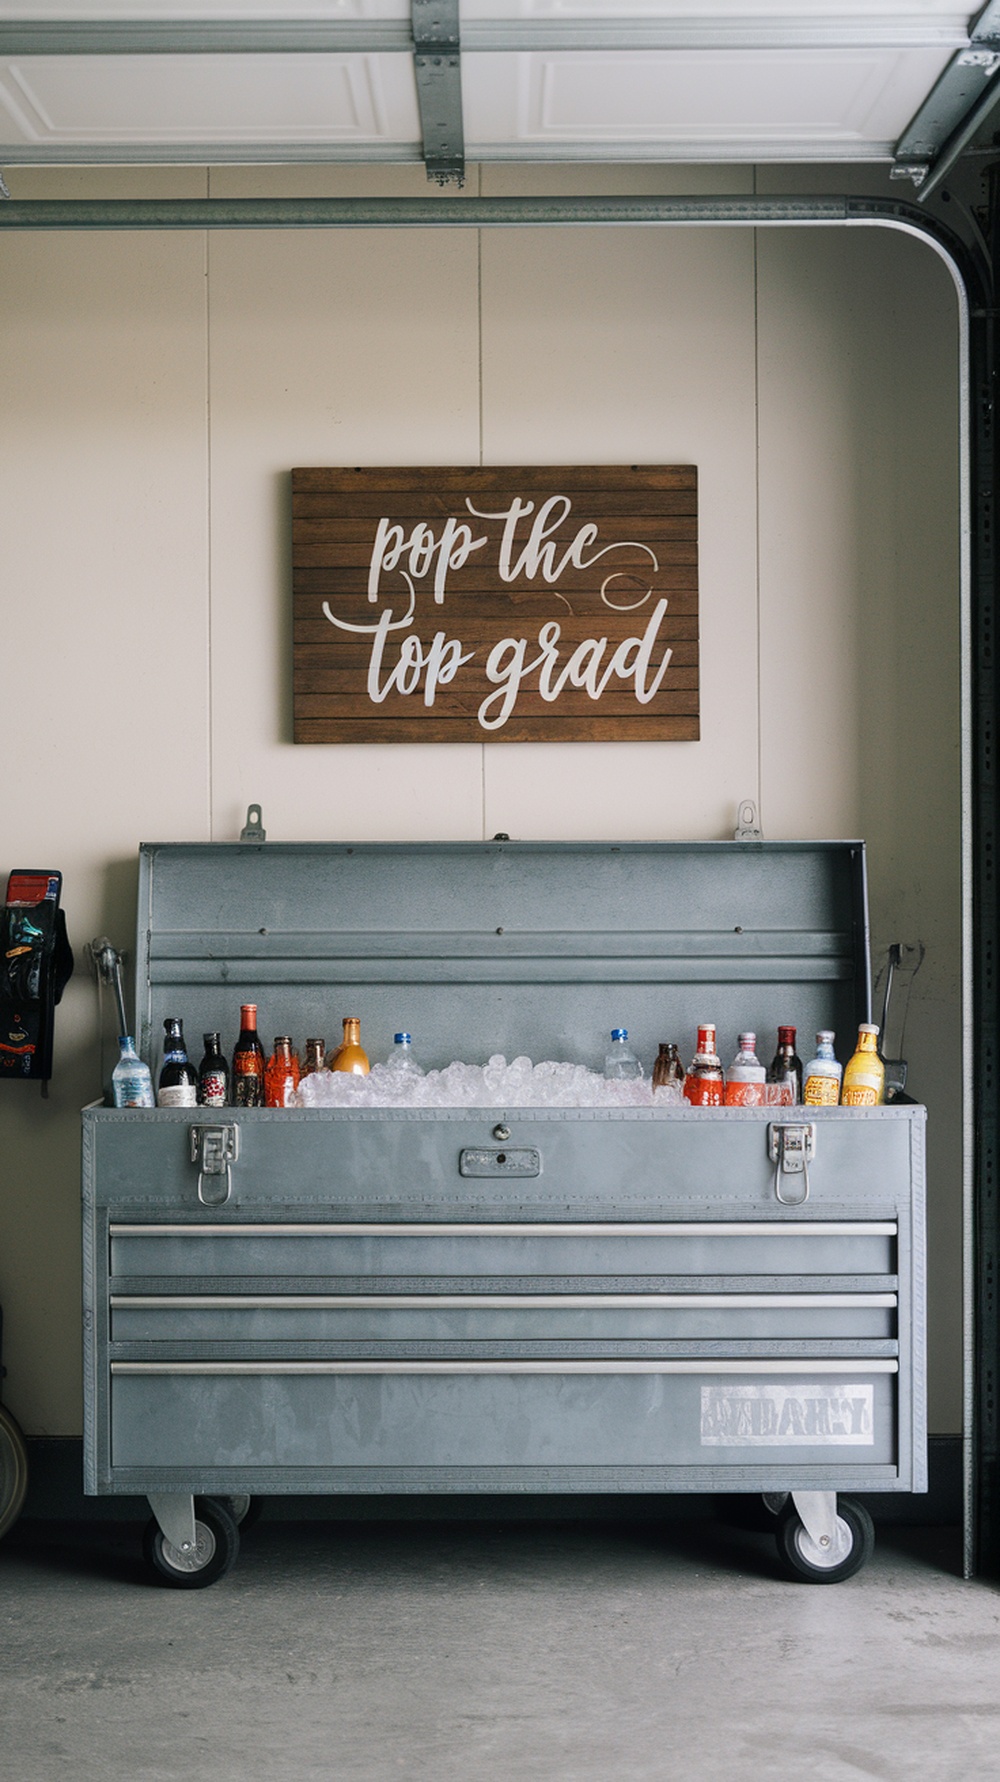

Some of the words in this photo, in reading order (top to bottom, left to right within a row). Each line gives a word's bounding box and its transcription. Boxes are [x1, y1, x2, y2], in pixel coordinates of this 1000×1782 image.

[368, 517, 488, 604] pop
[465, 495, 660, 583] the
[321, 600, 476, 707] top
[478, 598, 673, 730] grad
